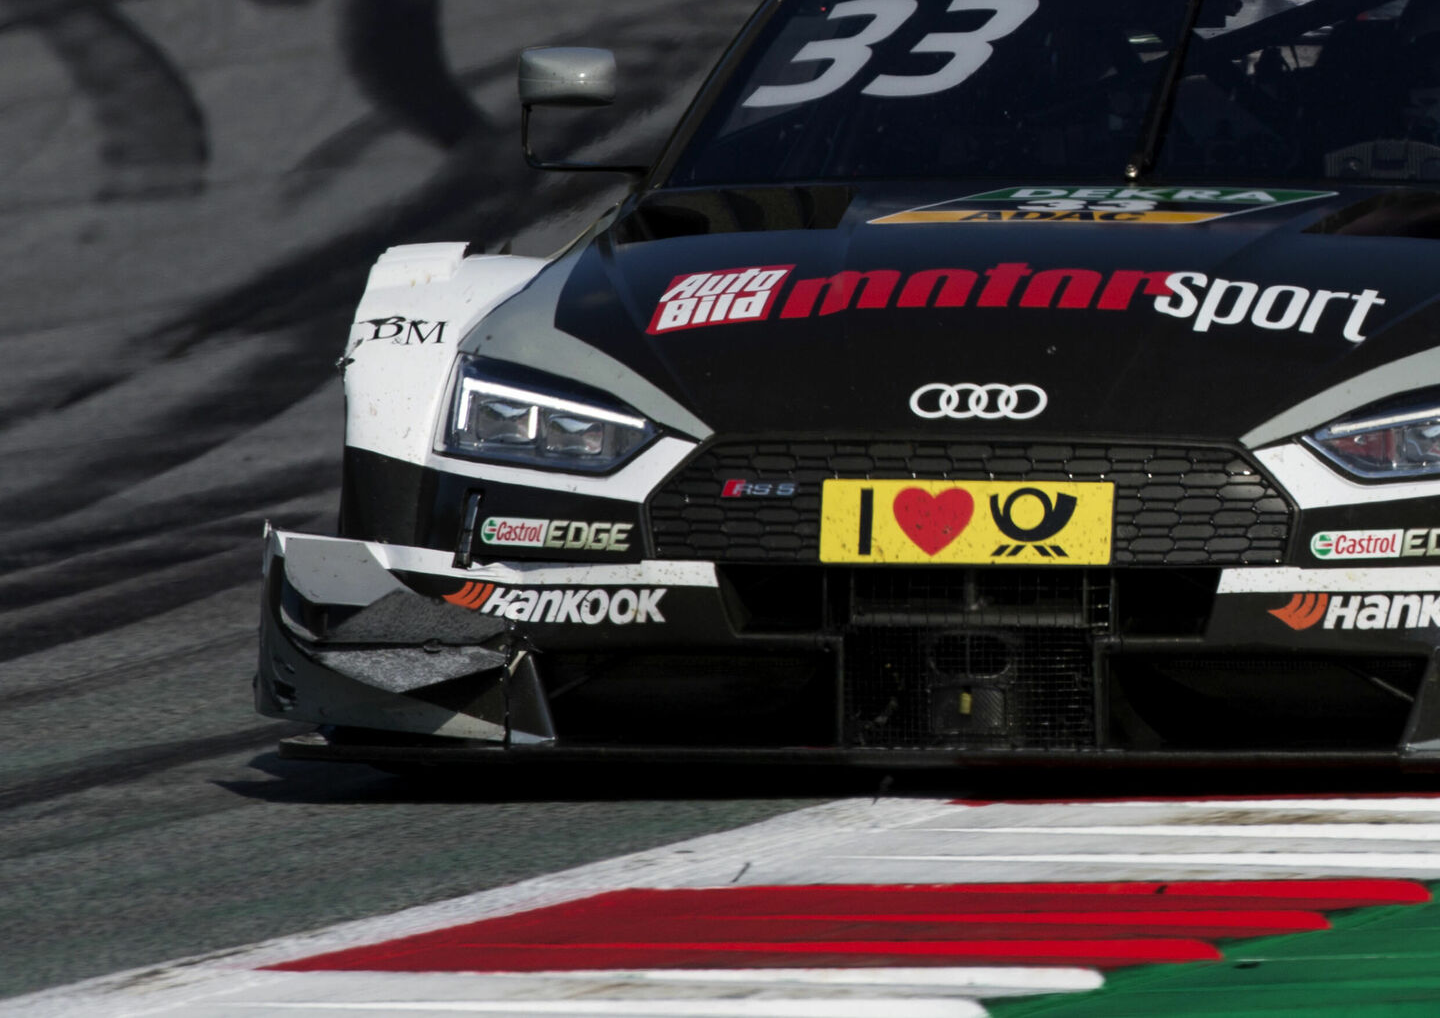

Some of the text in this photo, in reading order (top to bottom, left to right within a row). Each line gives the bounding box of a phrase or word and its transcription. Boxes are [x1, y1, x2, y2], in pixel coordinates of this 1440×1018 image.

[1009, 187, 1278, 203] DEKRA
[958, 211, 1147, 222] ADAC
[658, 268, 788, 303] Auto
[655, 290, 771, 331] Bild
[496, 520, 633, 552] Castrol EDGE
[858, 488, 874, 556] I
[1334, 533, 1397, 555] Castrol
